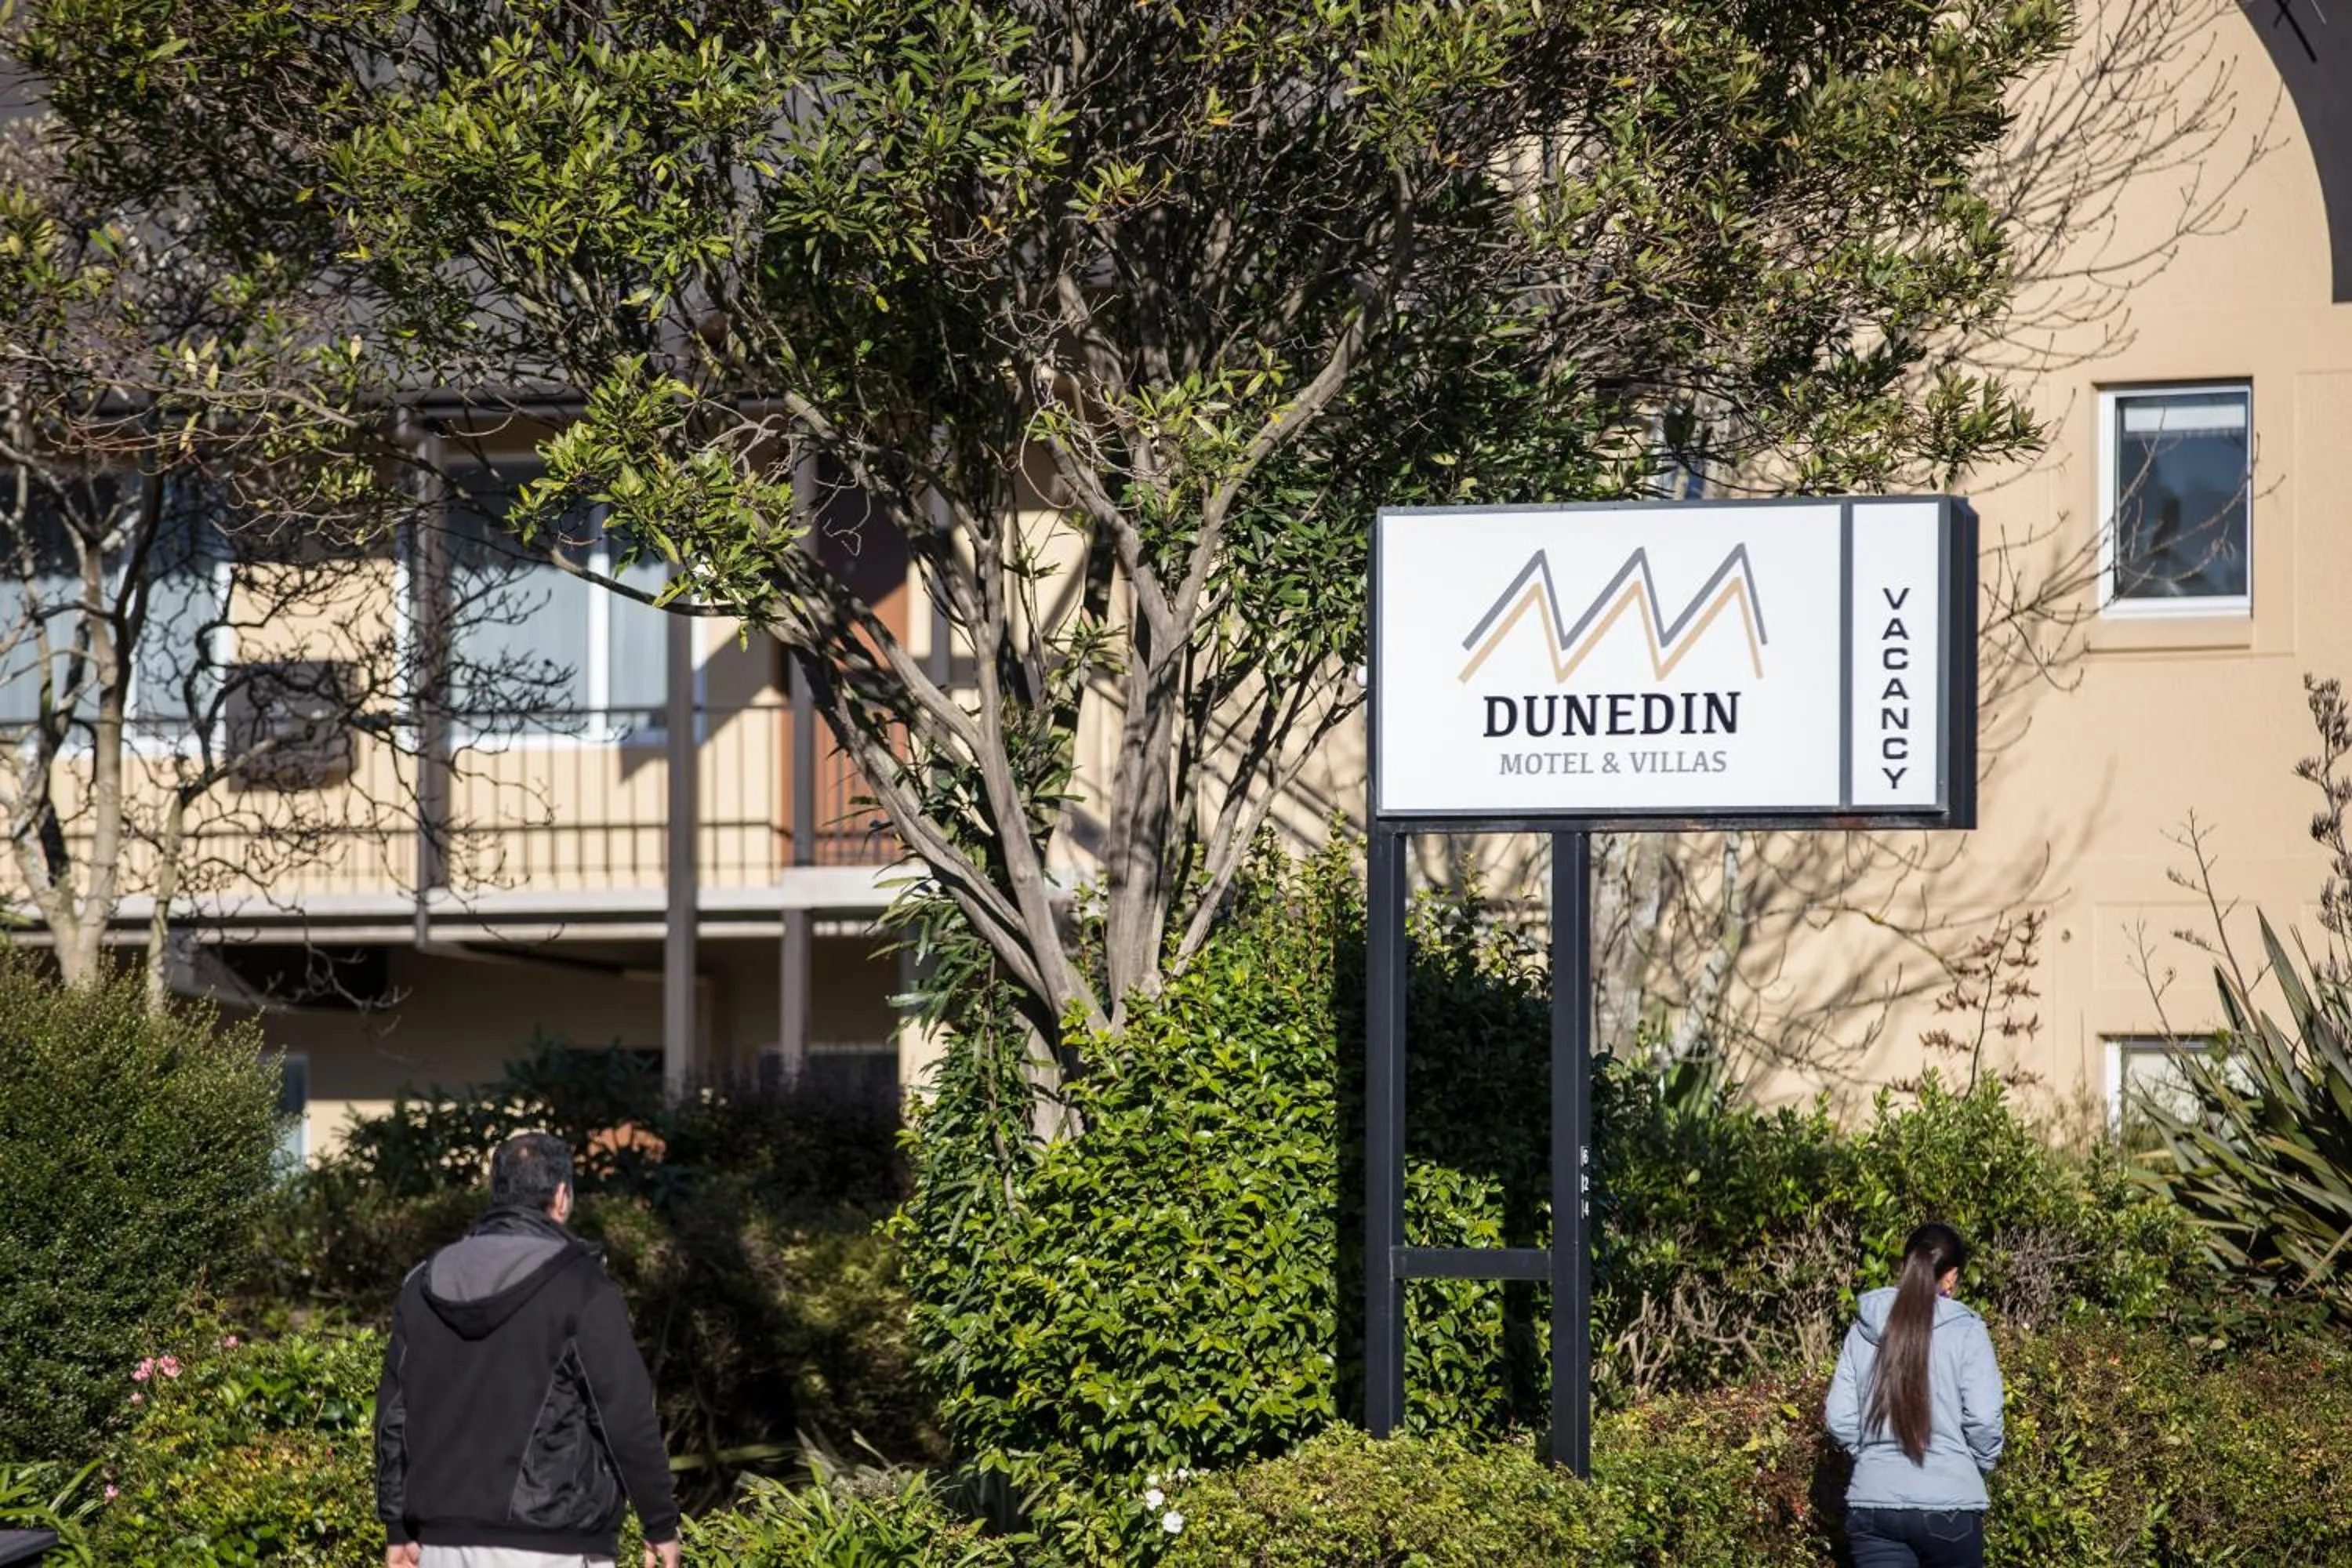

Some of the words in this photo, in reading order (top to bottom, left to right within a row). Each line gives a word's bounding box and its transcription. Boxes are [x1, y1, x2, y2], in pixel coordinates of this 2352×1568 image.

[1881, 587, 1910, 789] VACANCY
[1483, 691, 1741, 738] DUNEDIN
[1499, 752, 1595, 776] MOTEL
[1601, 751, 1621, 774] &
[1628, 750, 1727, 774] VILLAS
